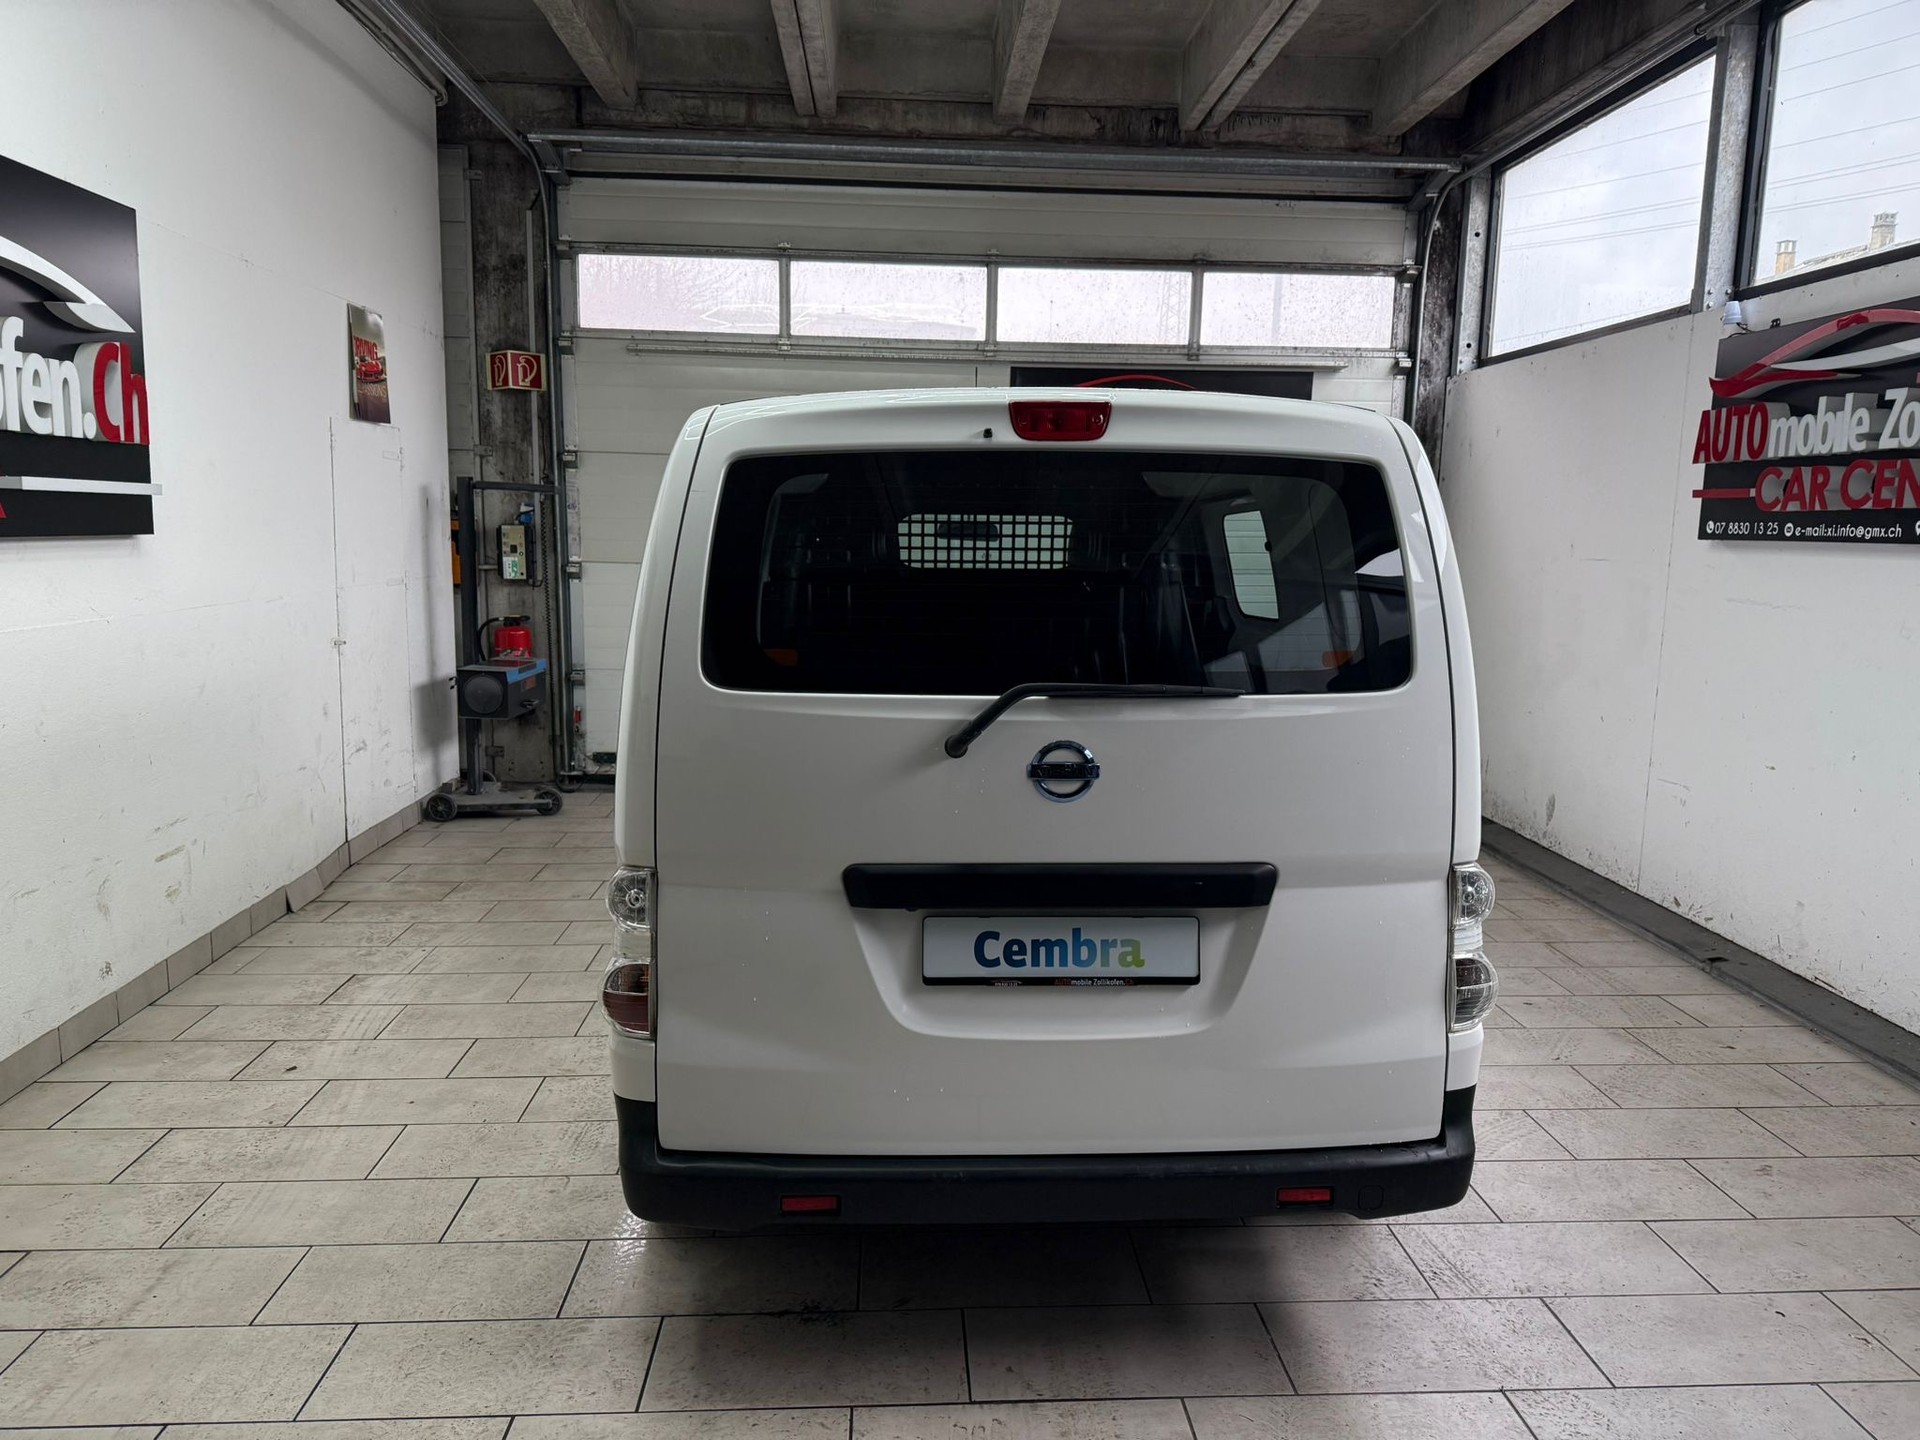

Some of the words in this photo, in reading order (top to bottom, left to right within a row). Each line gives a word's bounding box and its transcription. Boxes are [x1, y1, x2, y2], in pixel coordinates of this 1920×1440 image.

[0, 316, 150, 445] fen.Ch
[1692, 392, 1870, 464] AUTOmobile
[1755, 464, 1831, 512] CAR
[1840, 458, 1920, 510] CEN
[1714, 522, 1726, 534] 07
[1727, 522, 1750, 534] 8830
[1753, 522, 1764, 535] 13
[1766, 522, 1779, 535] 25
[973, 927, 1146, 969] Cembra
